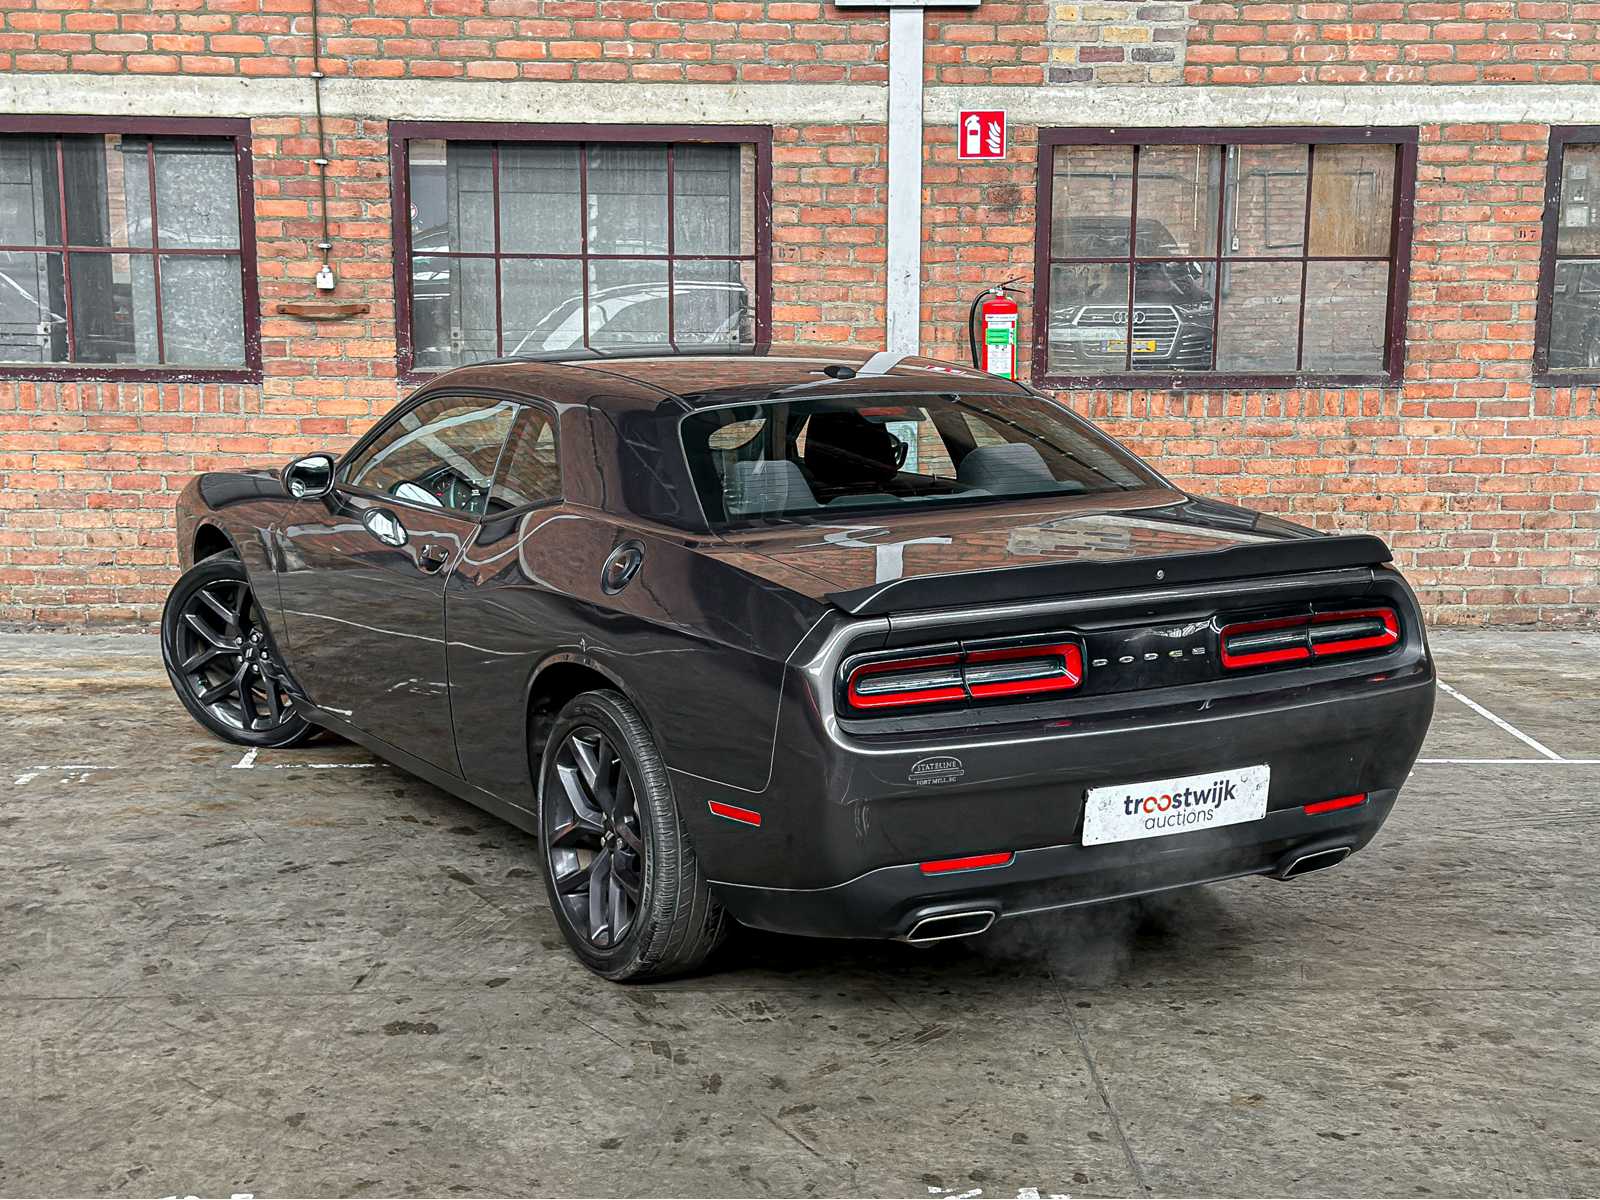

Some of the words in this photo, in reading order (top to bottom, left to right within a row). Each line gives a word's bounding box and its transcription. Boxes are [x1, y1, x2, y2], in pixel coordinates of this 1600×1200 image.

[1092, 647, 1205, 667] DODGE
[917, 761, 957, 771] STATELINE
[1124, 780, 1236, 815] troostwijk
[1145, 807, 1214, 830] auctions
